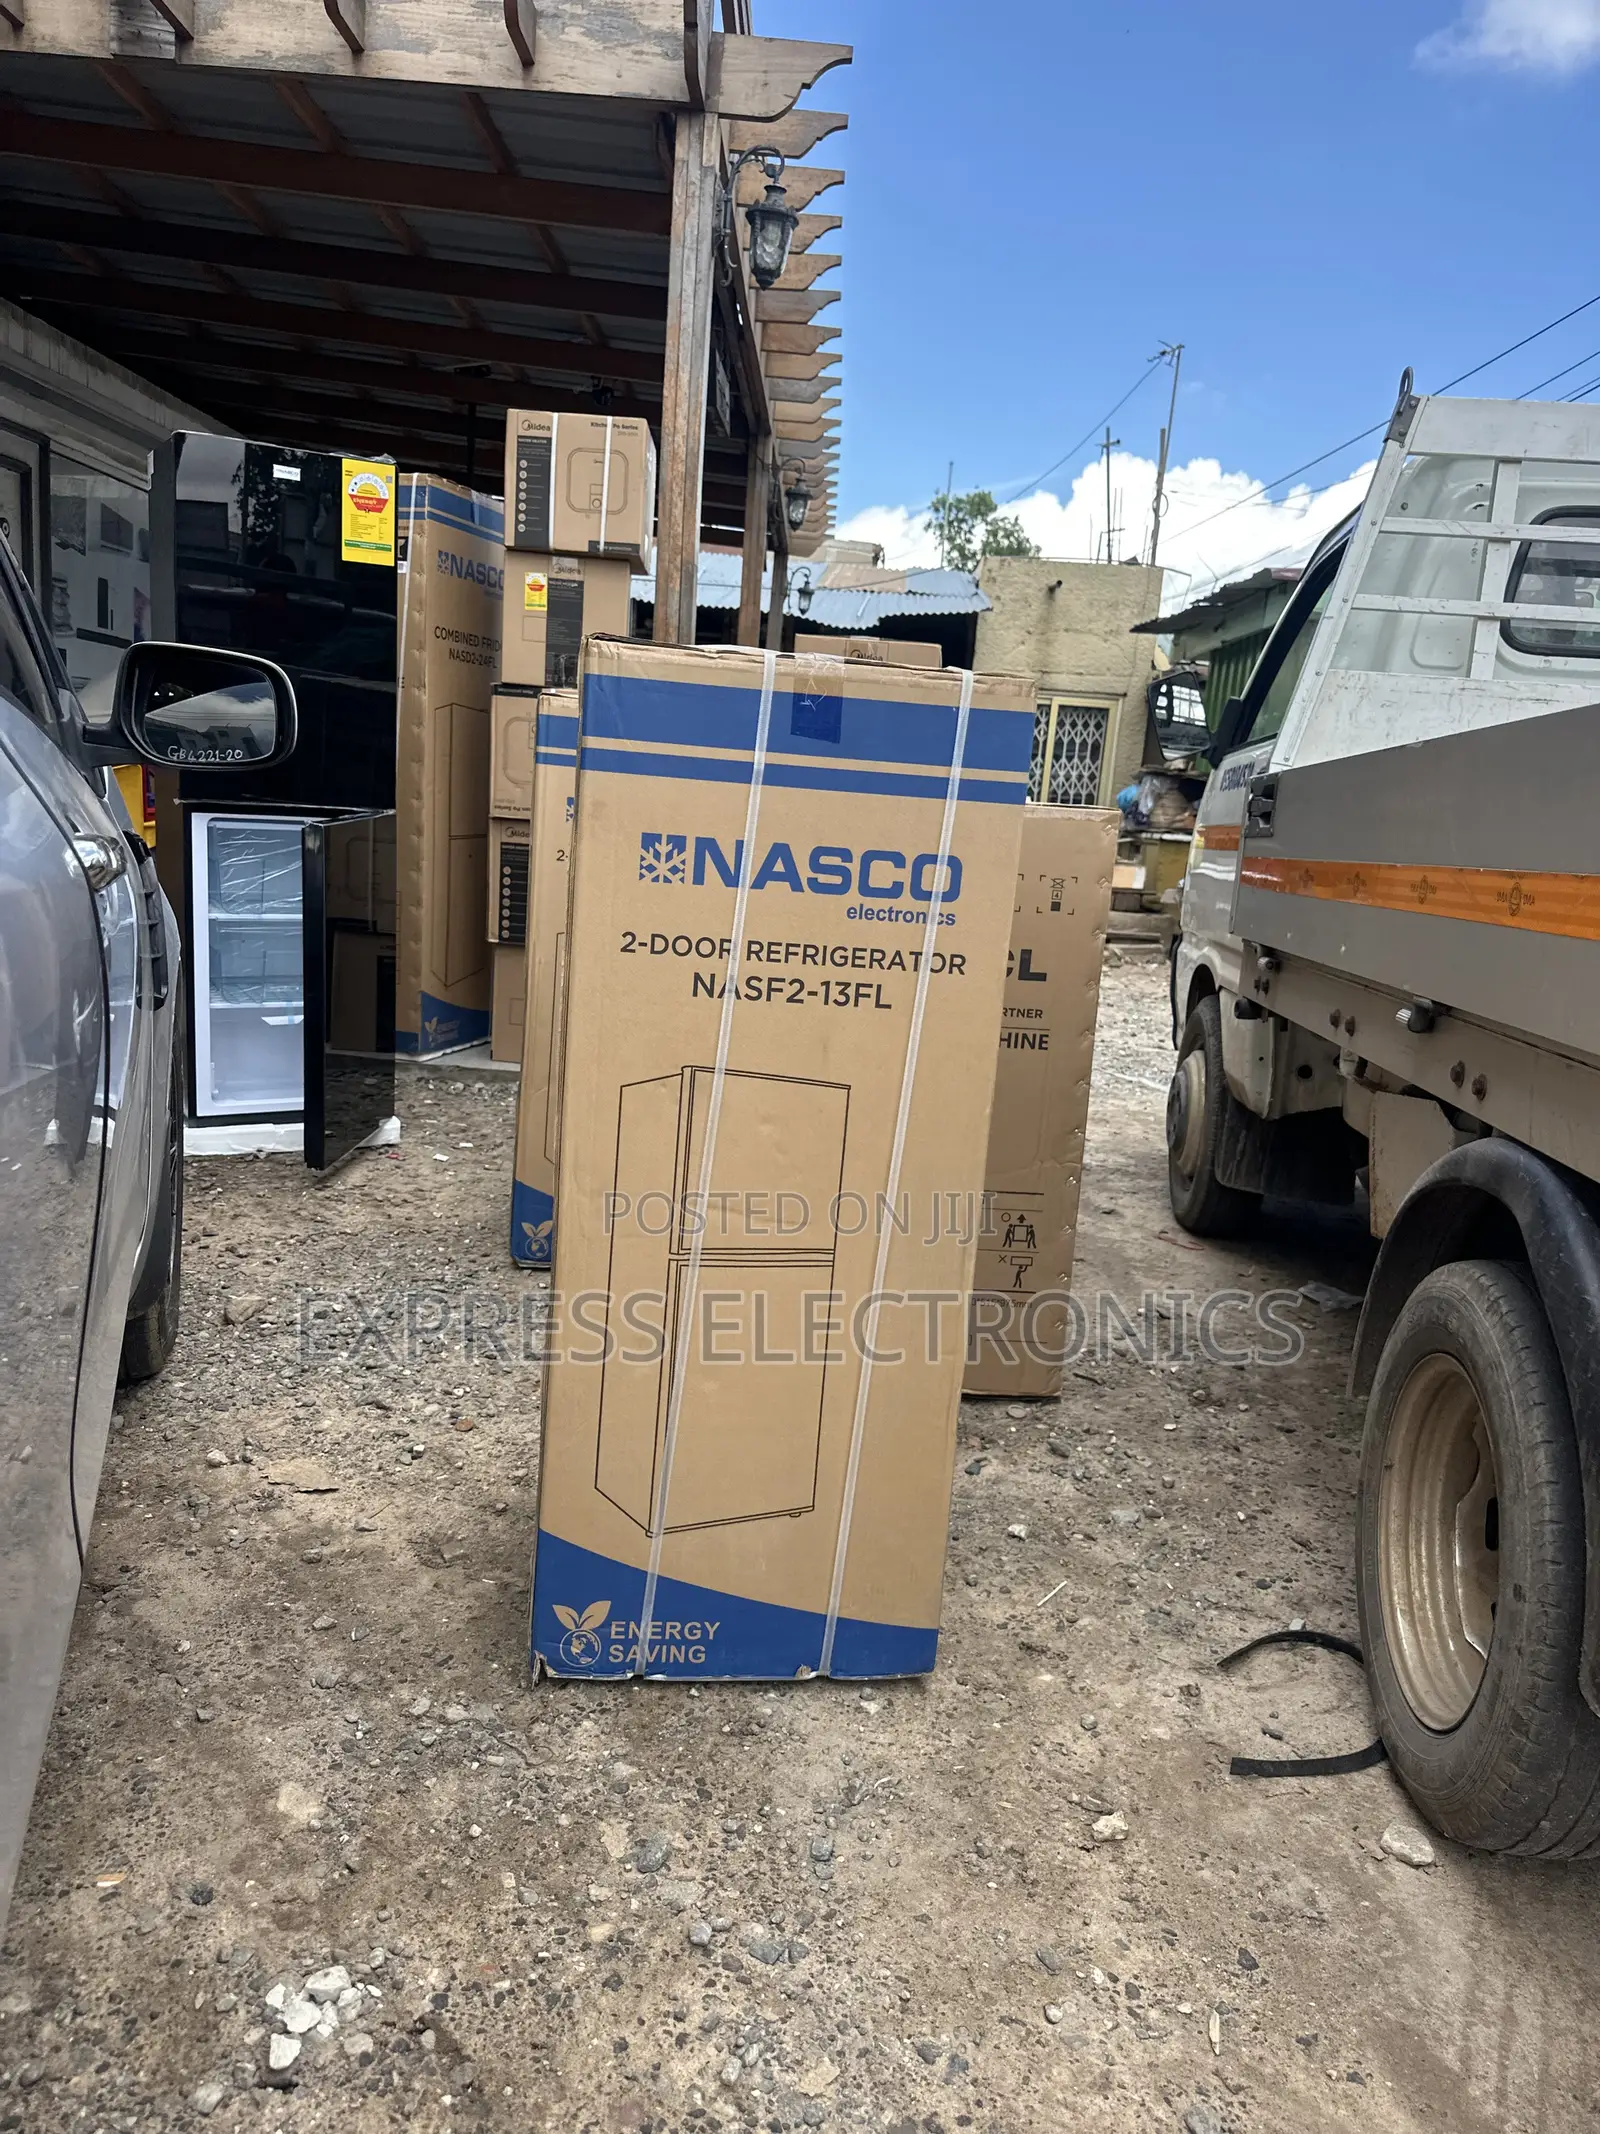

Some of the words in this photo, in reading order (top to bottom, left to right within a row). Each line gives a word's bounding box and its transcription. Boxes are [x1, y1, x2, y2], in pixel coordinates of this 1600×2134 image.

[521, 419, 551, 432] Midea
[434, 626, 480, 648] COMBINED
[481, 636, 502, 653] FRID
[504, 826, 531, 838] Mide
[692, 836, 964, 904] NASCO
[846, 903, 957, 926] electroncs
[619, 931, 738, 960] 2-DOOR
[745, 939, 967, 976] REFRIGERATOR
[691, 971, 893, 1010] NASF2-13FL
[609, 1621, 721, 1641] ENERGY
[608, 1644, 706, 1664] SAVING
